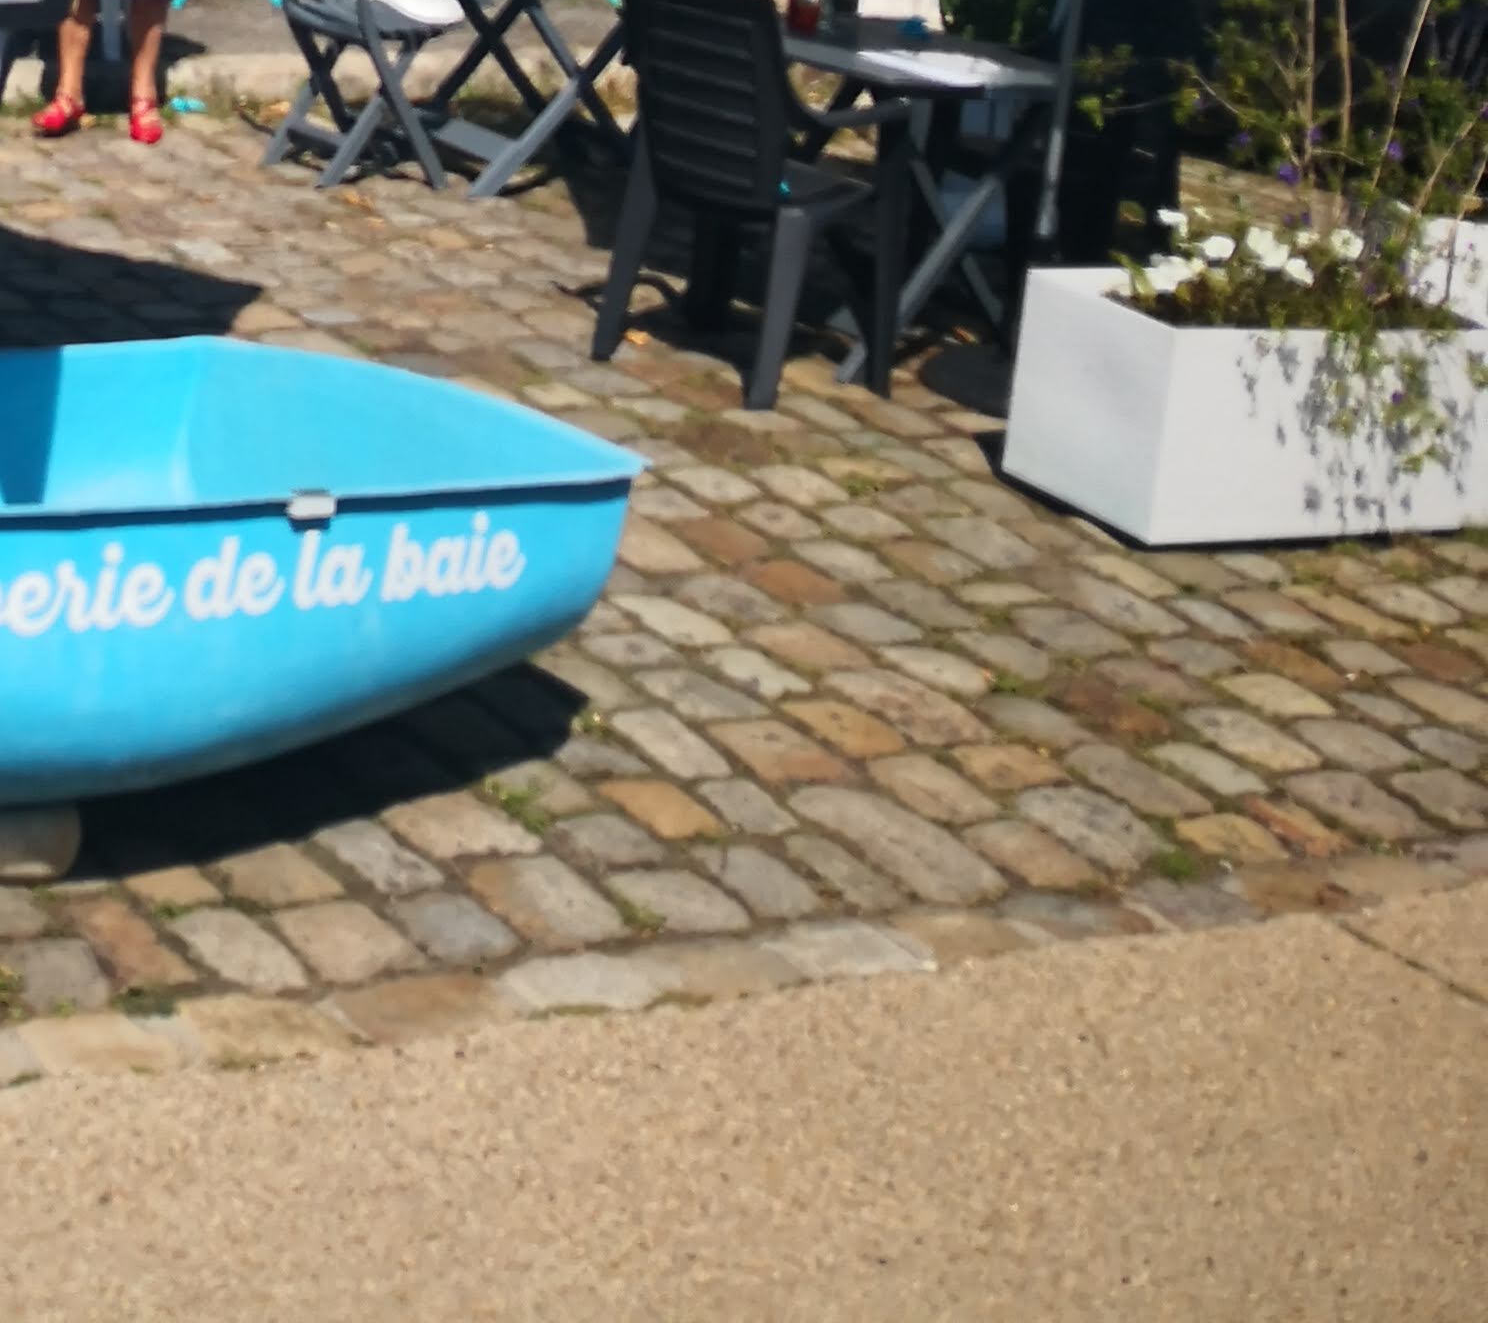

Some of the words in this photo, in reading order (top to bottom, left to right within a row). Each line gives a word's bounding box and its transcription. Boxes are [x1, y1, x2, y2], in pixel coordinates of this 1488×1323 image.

[183, 534, 286, 621] de
[293, 528, 374, 611] la
[380, 510, 528, 603] baie
